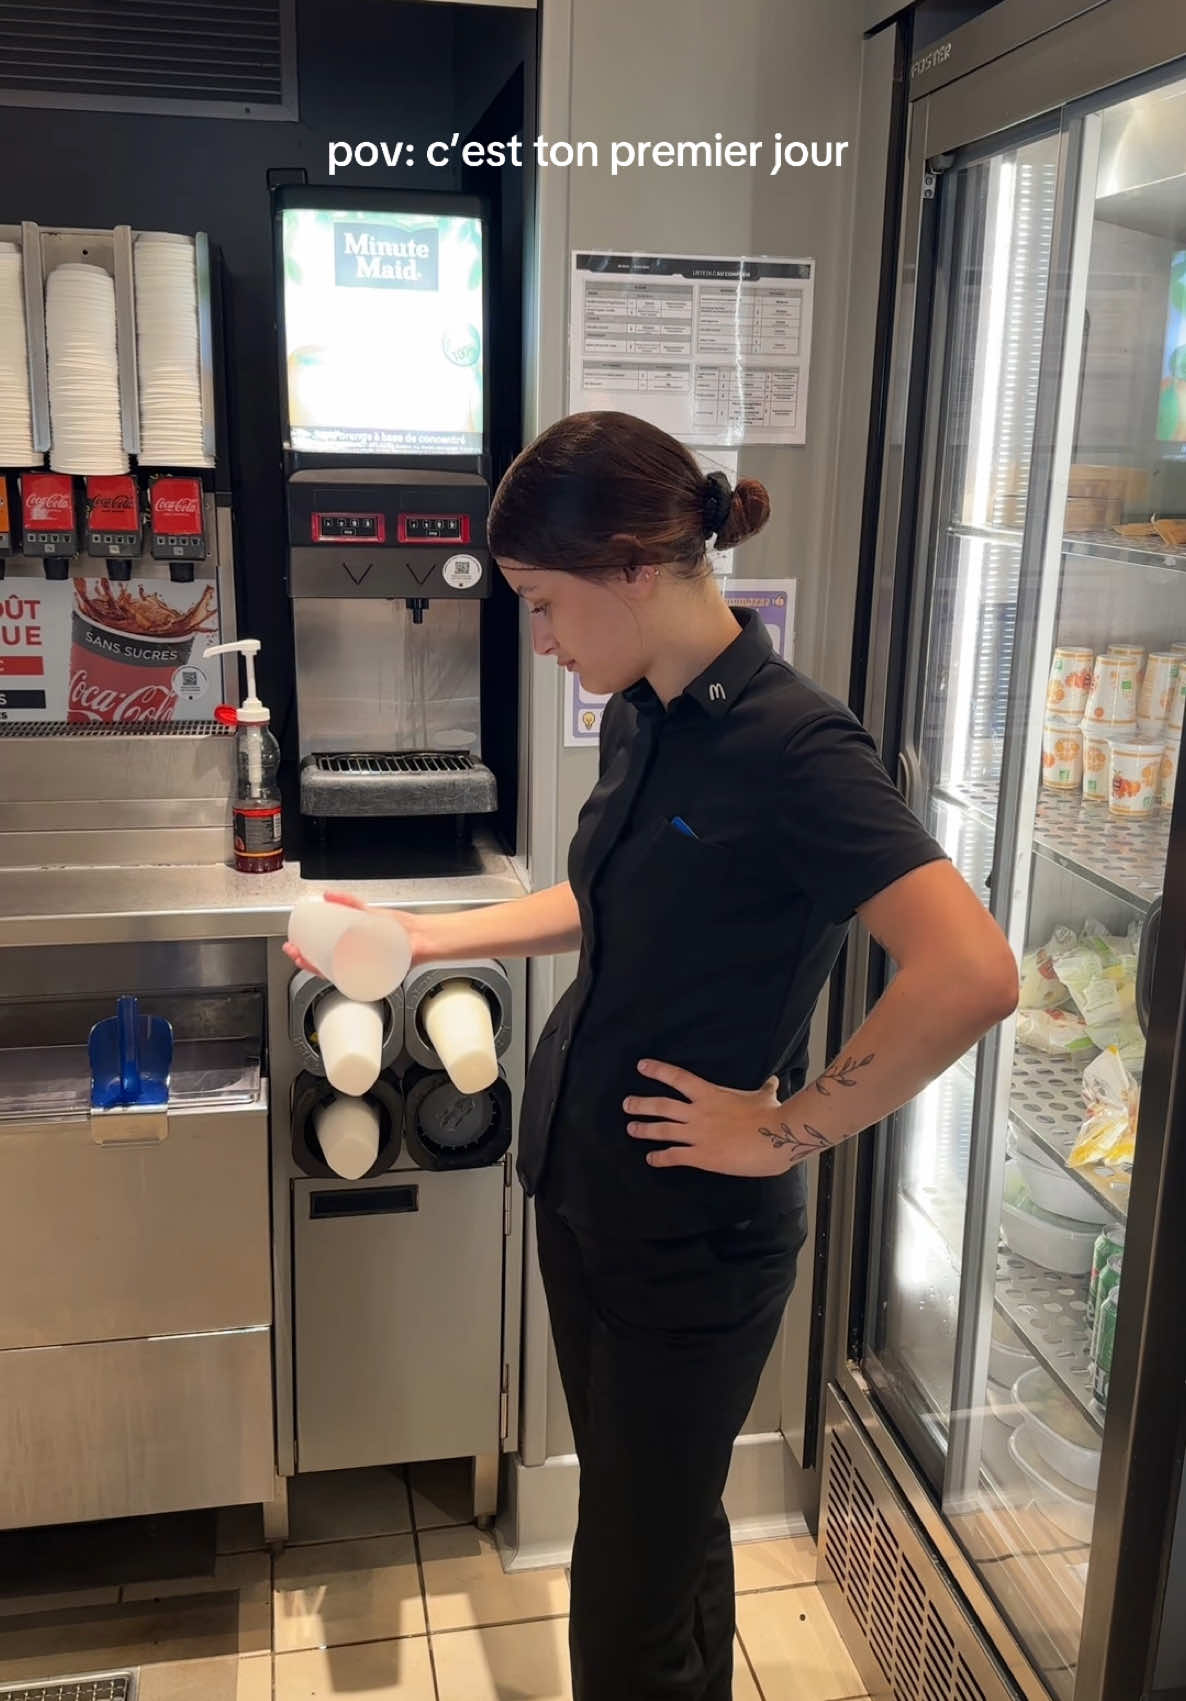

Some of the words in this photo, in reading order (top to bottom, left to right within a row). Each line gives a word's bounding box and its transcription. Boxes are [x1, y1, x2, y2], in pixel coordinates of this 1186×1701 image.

[343, 232, 429, 259] Minute
[155, 497, 199, 514] Coca-Cola
[0, 594, 41, 620] ÛT
[84, 631, 121, 654] SANS
[124, 646, 178, 661] SUCRES
